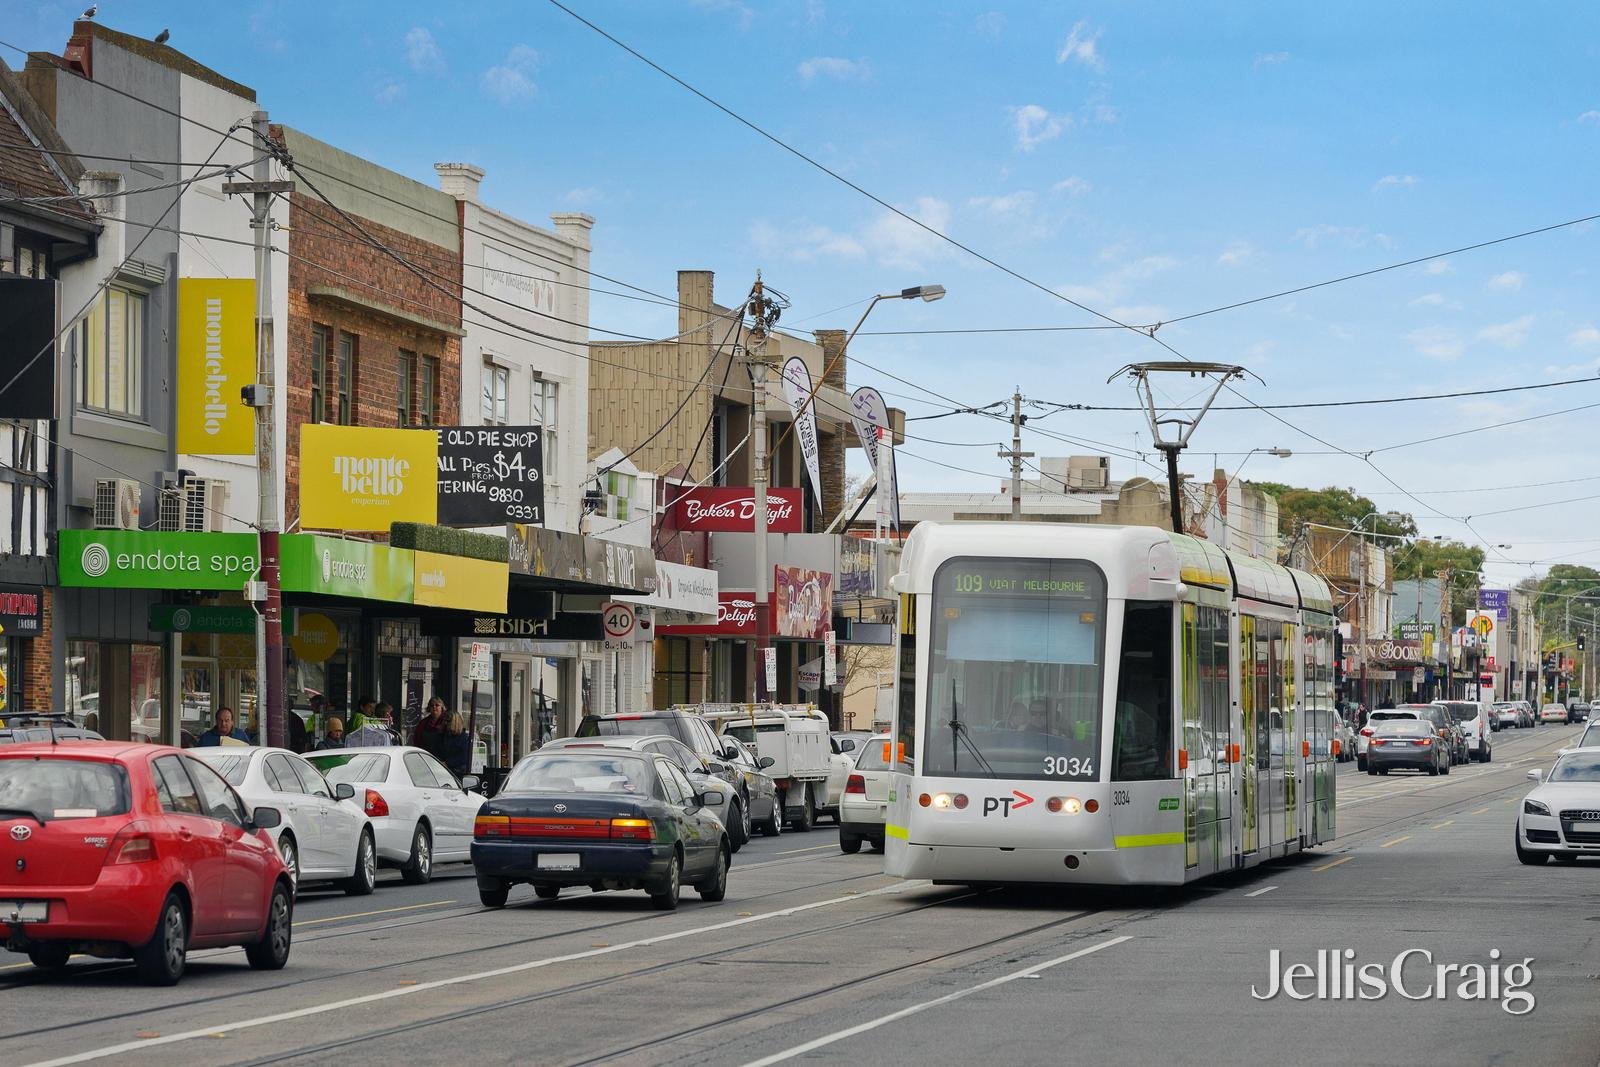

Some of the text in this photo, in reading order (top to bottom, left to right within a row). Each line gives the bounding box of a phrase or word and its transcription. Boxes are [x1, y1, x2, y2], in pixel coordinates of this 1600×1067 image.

[205, 298, 227, 435] montebello
[448, 430, 474, 445] OLD
[478, 431, 499, 446] PIE
[502, 431, 538, 447] SHOP
[333, 454, 410, 478] monte
[460, 457, 490, 473] Pies
[493, 450, 526, 481] $4
[341, 472, 404, 496] bello
[471, 473, 495, 481] FROM
[437, 480, 523, 502] TERING 9830
[506, 504, 539, 520] 0331
[685, 500, 793, 525] Bakers Dight
[116, 549, 257, 576] endota spa
[955, 574, 982, 592] 109
[1023, 580, 1085, 592] MELBOURNE
[0, 593, 38, 616] UMPLING
[608, 614, 629, 628] 40
[1043, 756, 1094, 776] 3034
[1113, 790, 1130, 806] 3034
